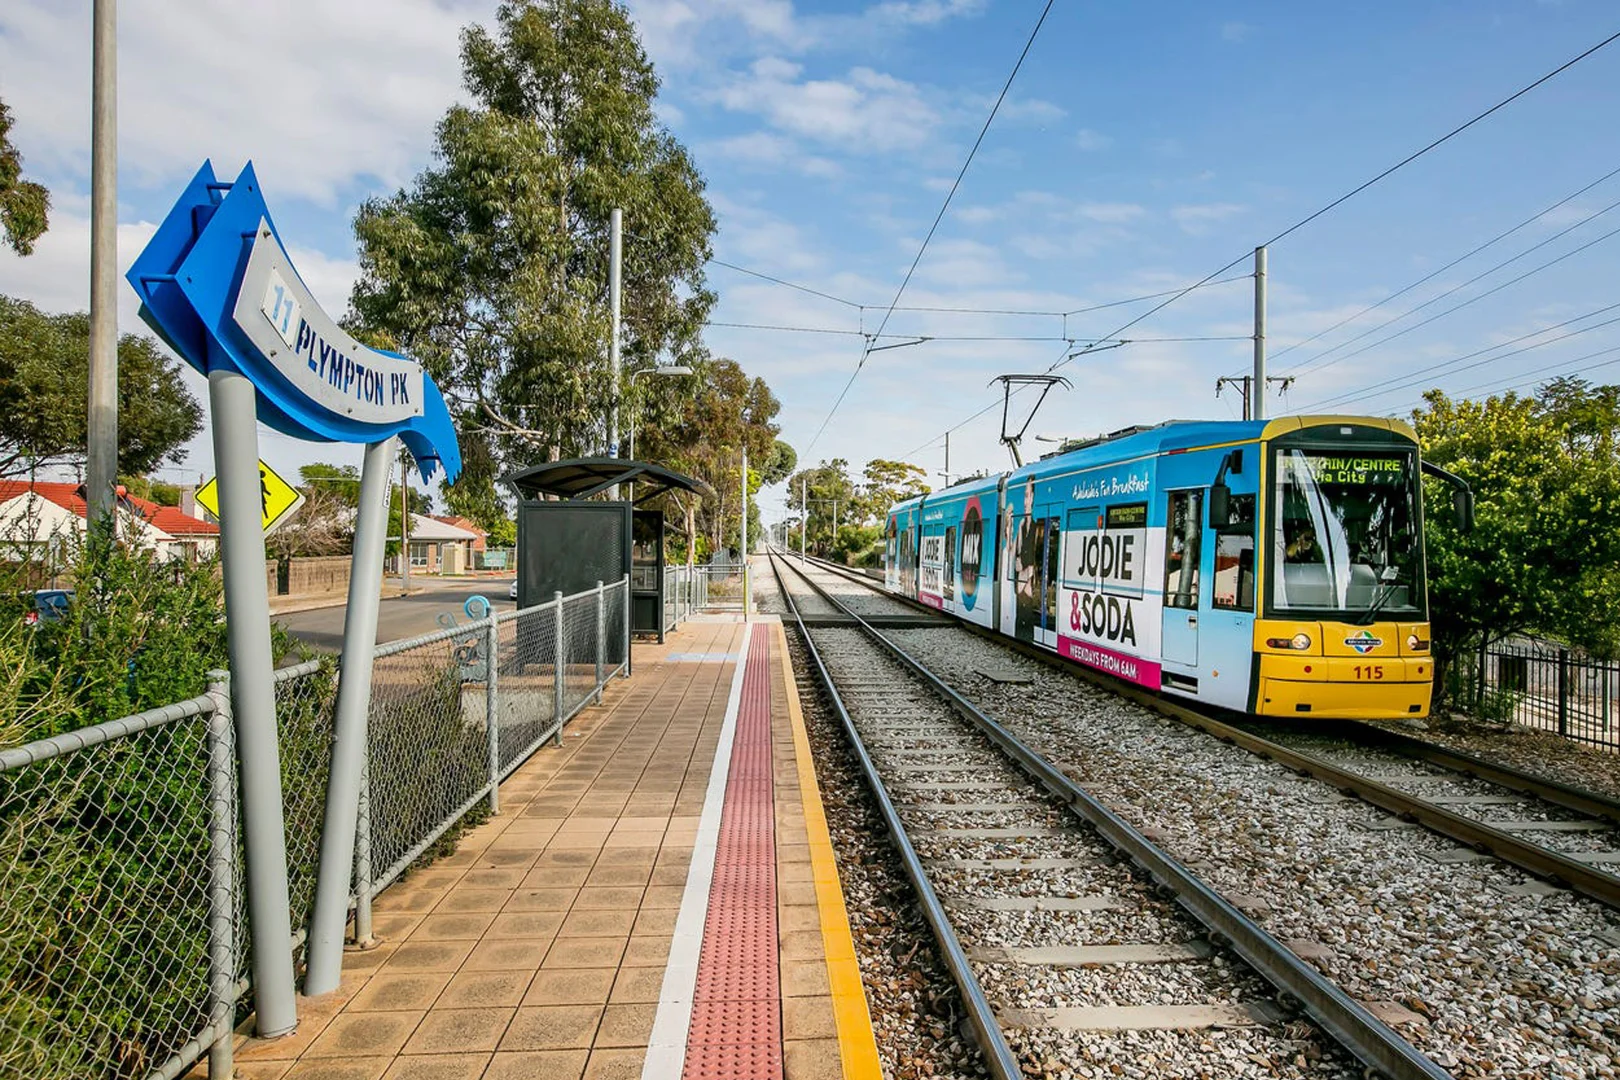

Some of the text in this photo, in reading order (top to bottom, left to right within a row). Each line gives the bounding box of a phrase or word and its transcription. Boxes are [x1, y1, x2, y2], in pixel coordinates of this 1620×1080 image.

[273, 285, 294, 334] 11
[295, 318, 409, 406] PLYMPTON PK
[1313, 470, 1366, 484] Via City
[962, 533, 980, 565] MIX
[1078, 534, 1135, 581] JODIE
[1070, 591, 1137, 647] &SODA
[1070, 643, 1137, 680] WEEKDAYS FROM 6AM
[1354, 665, 1383, 680] 115
